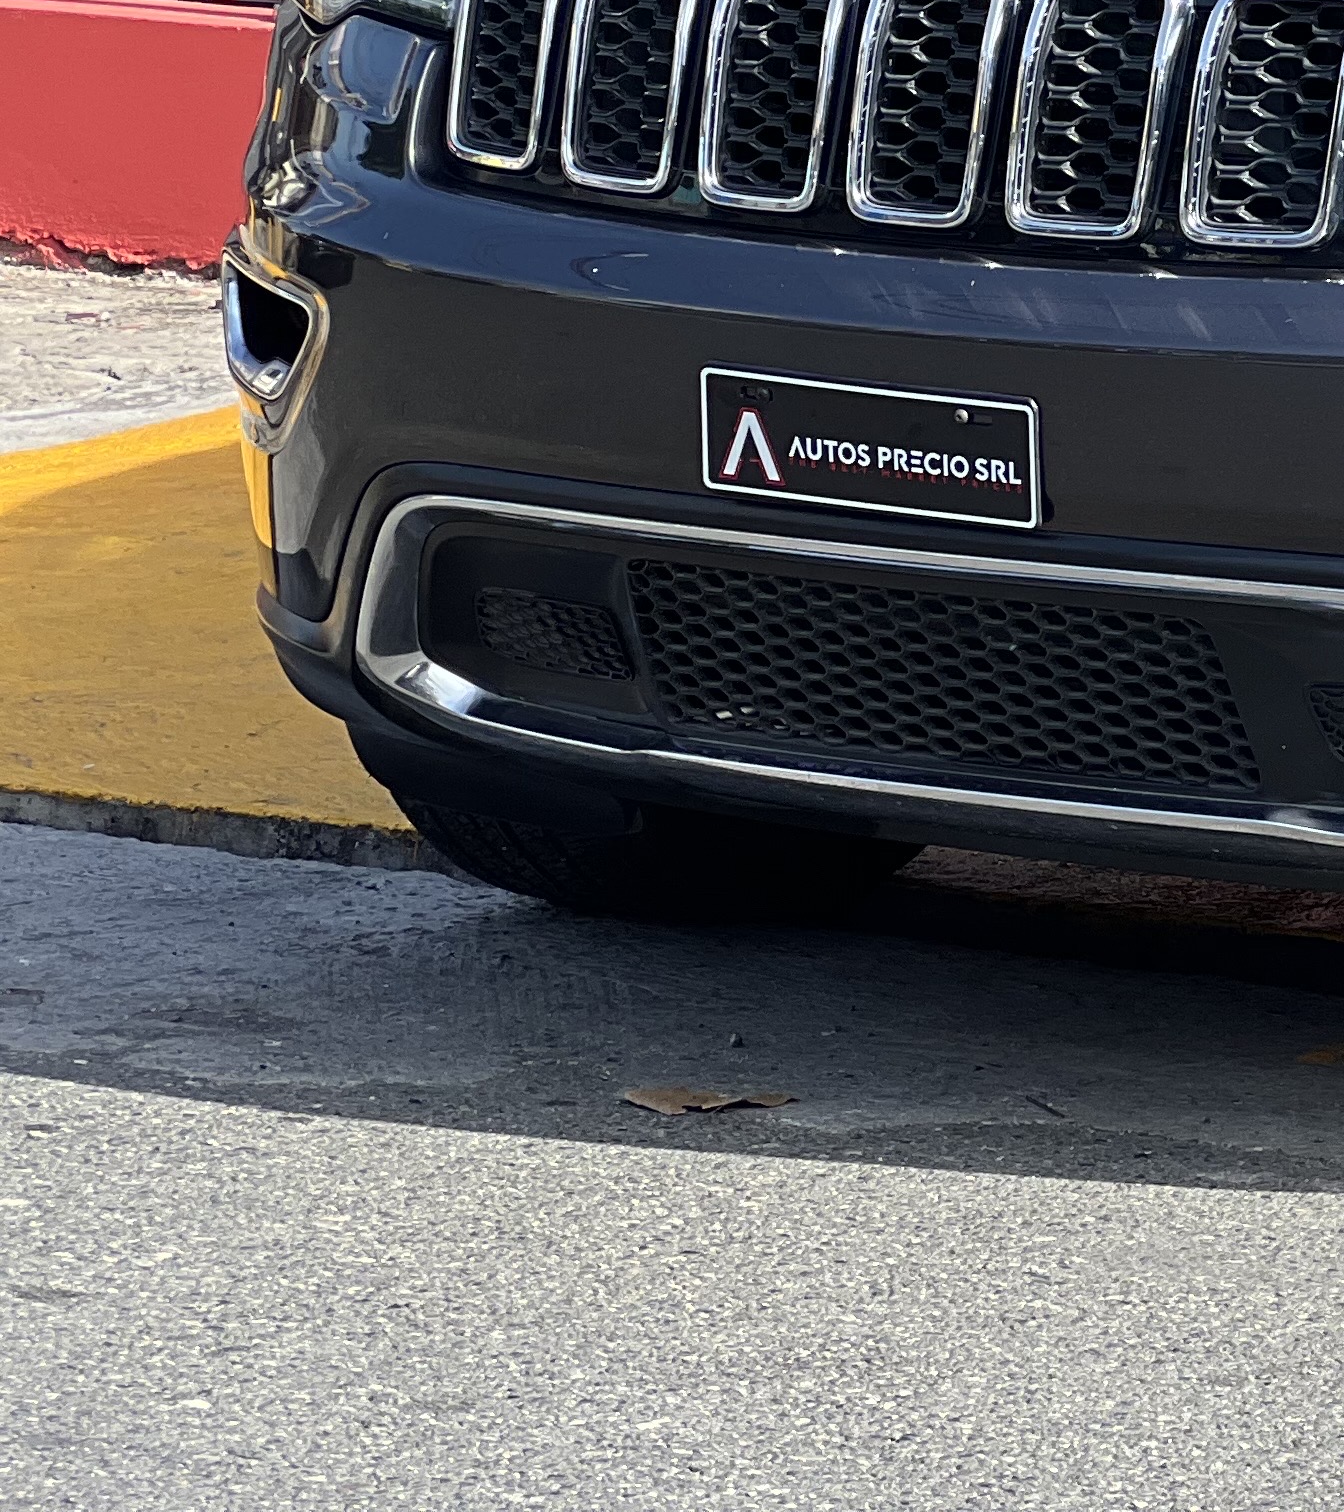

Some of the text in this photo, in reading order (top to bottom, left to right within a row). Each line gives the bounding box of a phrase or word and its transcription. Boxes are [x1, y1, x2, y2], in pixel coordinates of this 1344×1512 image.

[788, 435, 1023, 485] AUTOS PRECIO SRL
